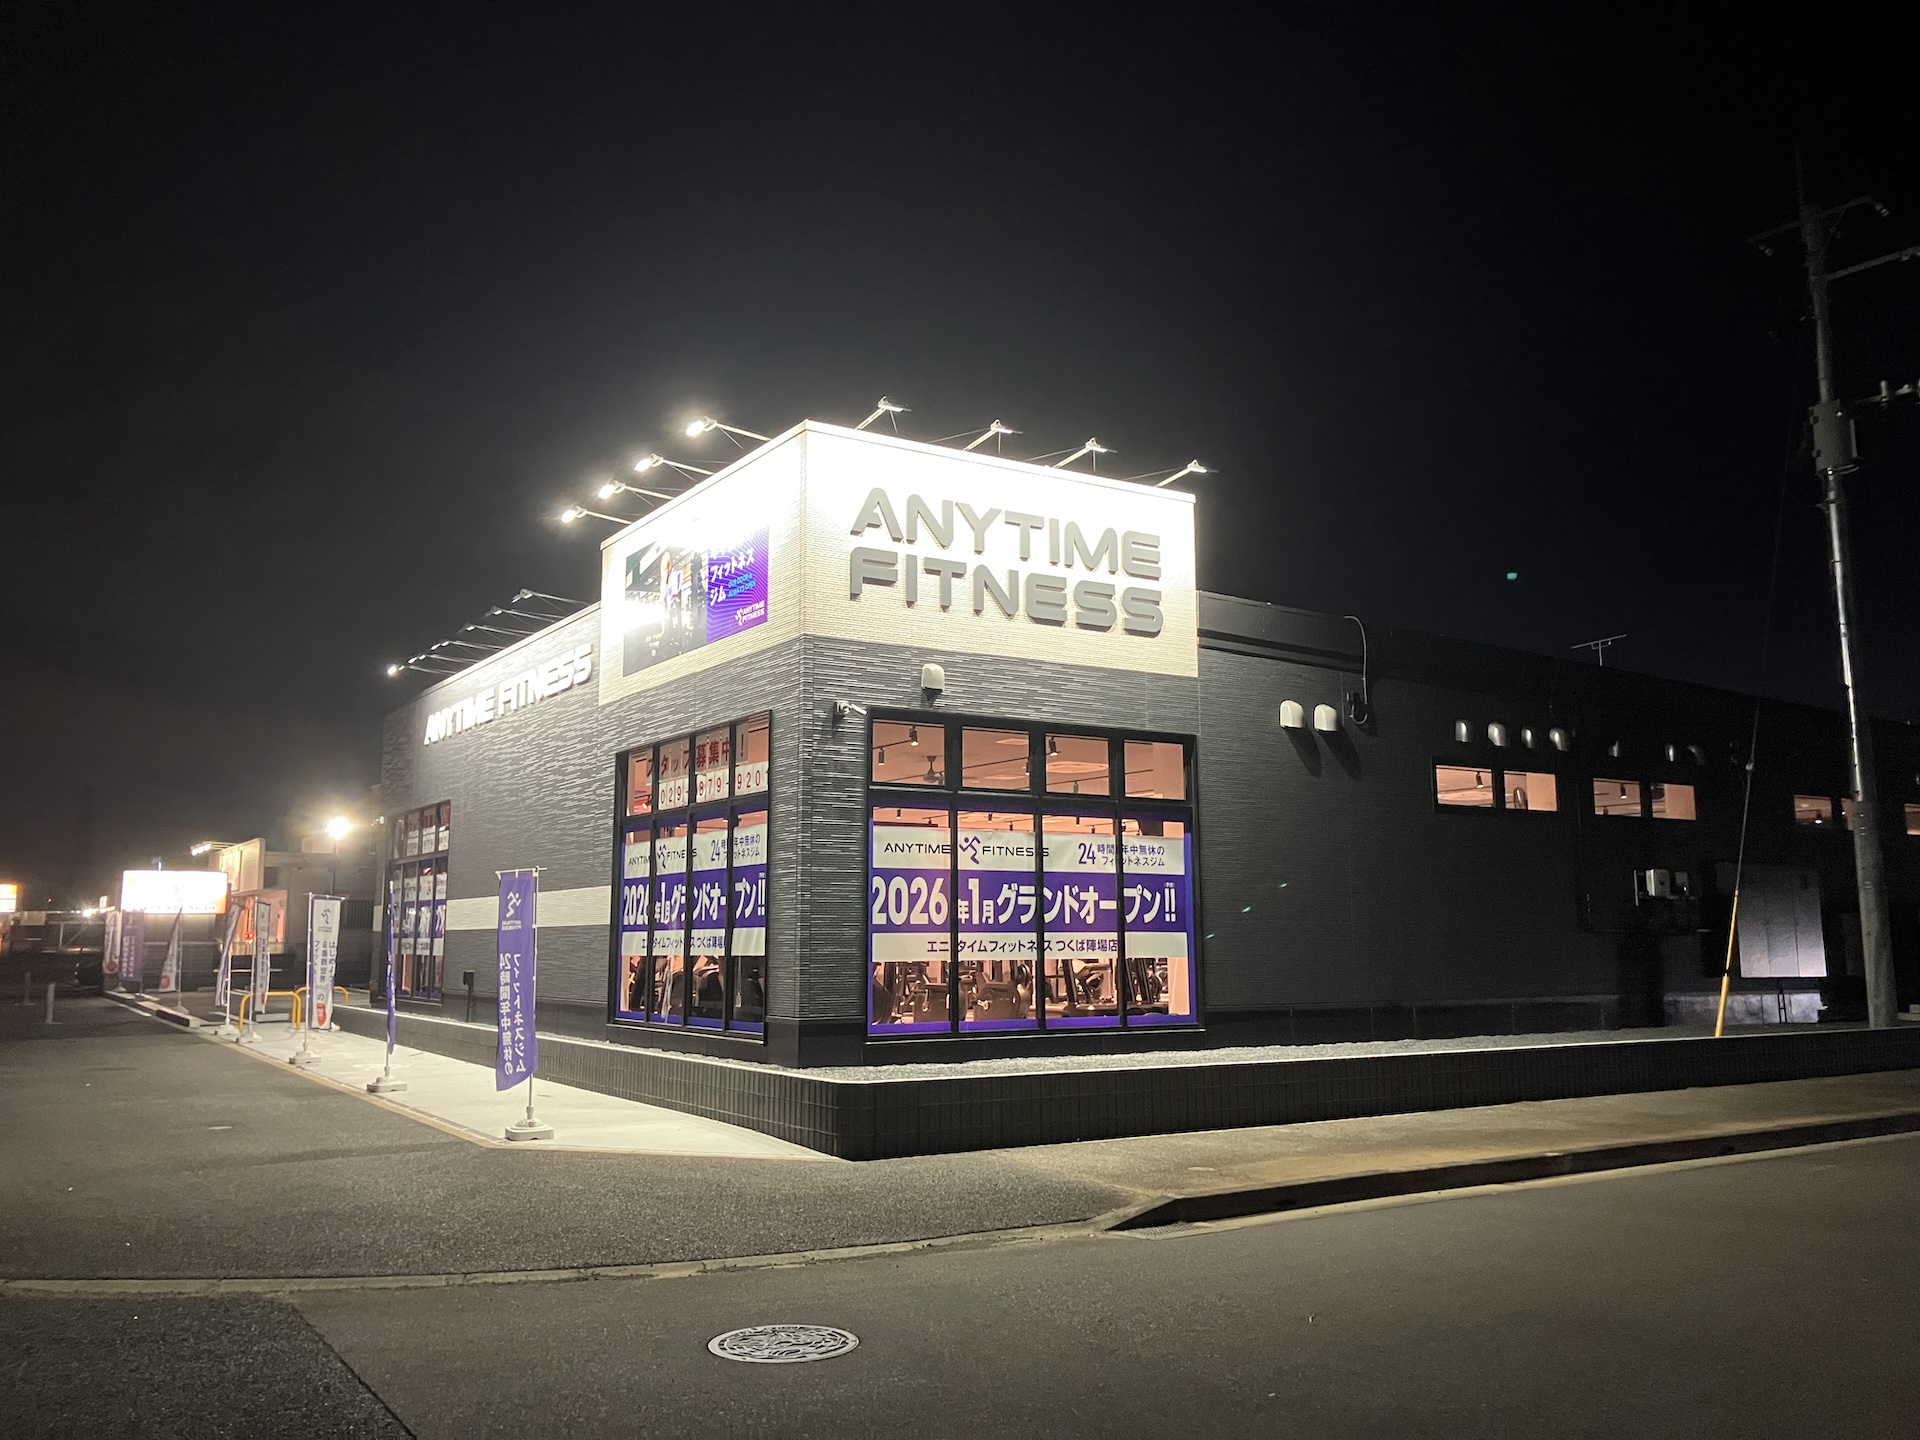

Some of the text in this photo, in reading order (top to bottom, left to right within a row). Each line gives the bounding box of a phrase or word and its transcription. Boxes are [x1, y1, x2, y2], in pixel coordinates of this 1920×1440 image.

[850, 487, 1161, 581] ANYTIME
[709, 586, 726, 606] ジム
[850, 546, 1164, 638] FITNESS
[424, 643, 593, 746] ANYTIME FITNESS
[711, 839, 720, 861] 24
[884, 842, 951, 854] ANYTIME
[1078, 842, 1096, 865] 24
